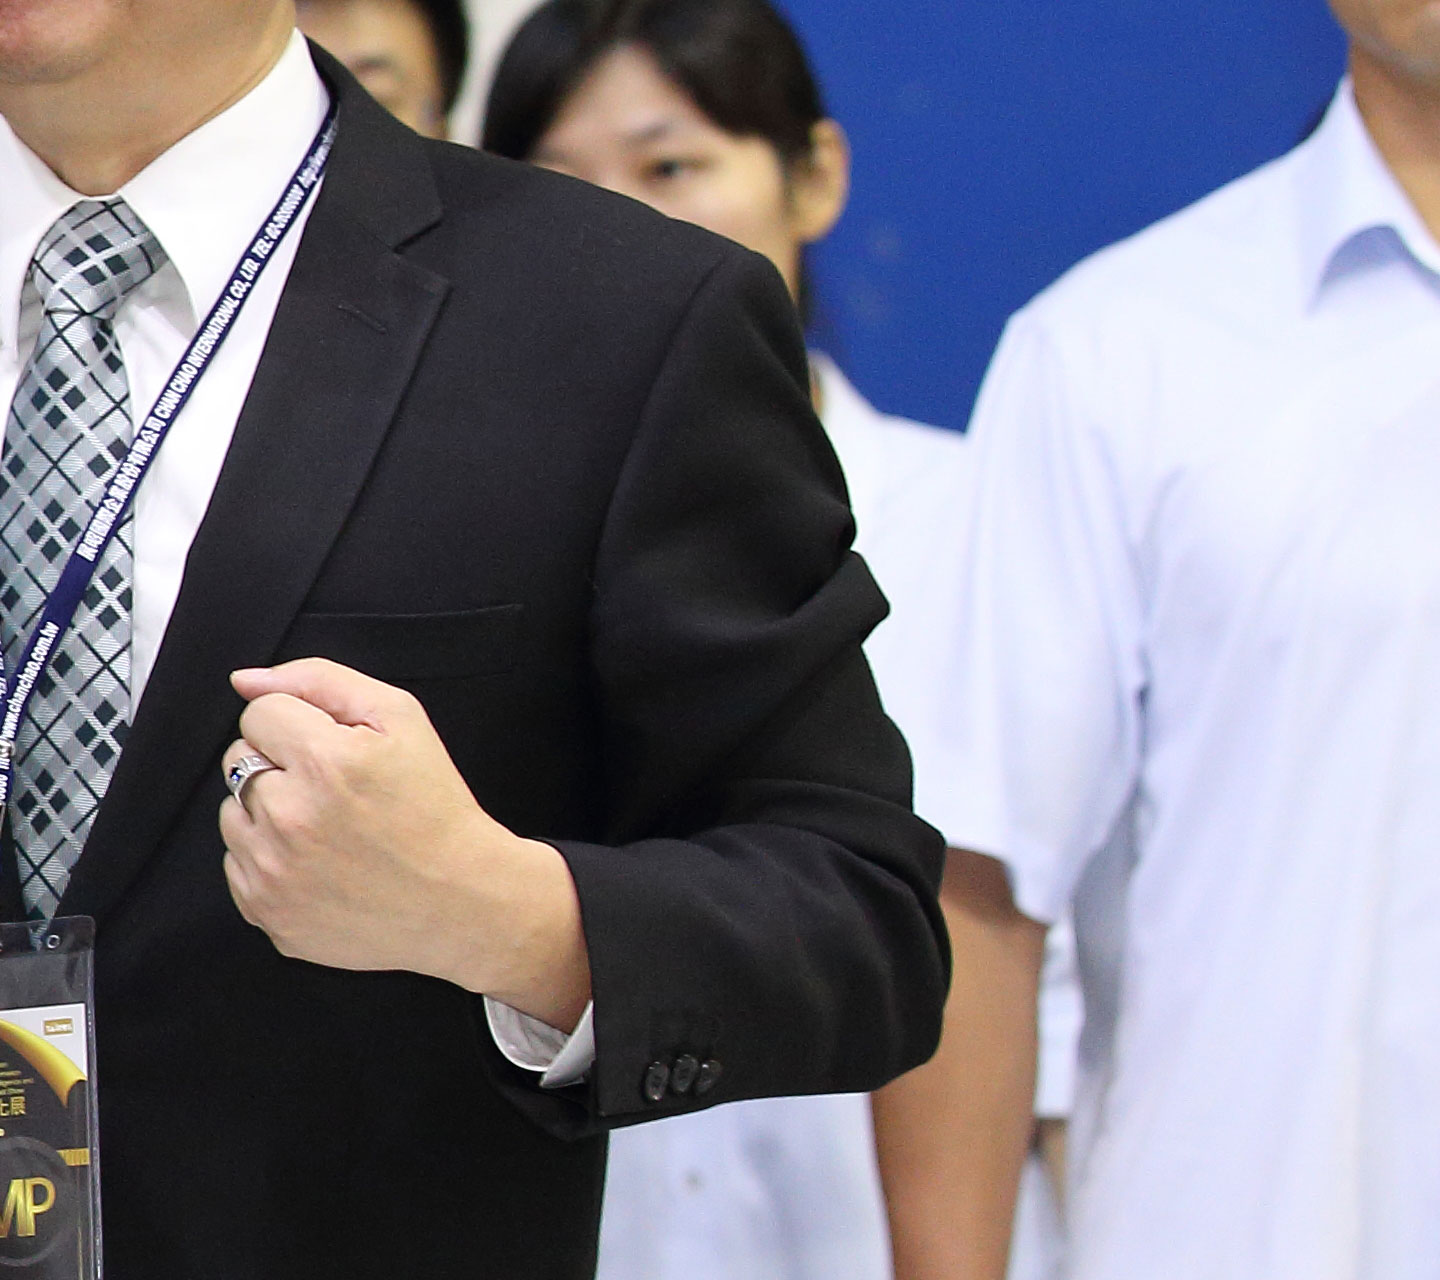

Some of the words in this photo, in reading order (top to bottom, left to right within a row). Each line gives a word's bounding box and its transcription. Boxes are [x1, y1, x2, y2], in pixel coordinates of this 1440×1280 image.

[154, 389, 183, 419] CHAN
[169, 363, 198, 394] CHAO
[186, 295, 240, 368] INTERNATIONAL
